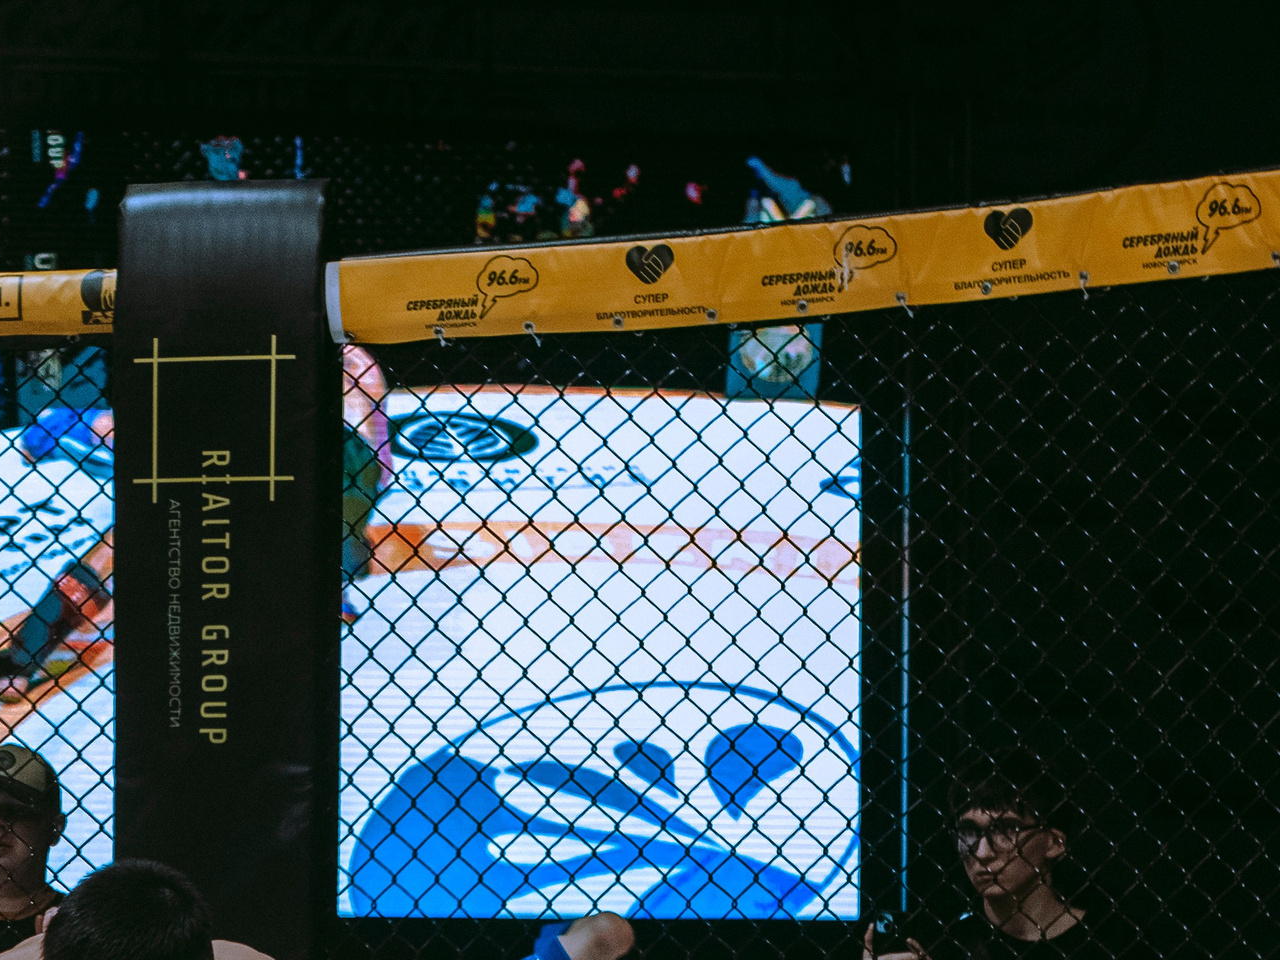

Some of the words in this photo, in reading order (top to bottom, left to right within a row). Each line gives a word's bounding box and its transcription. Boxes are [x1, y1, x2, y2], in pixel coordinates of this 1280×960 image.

[1122, 226, 1199, 248] СЕРЕБРЯНЫЙ
[1154, 244, 1198, 259] ДОЖДЬ
[991, 258, 1027, 272] СУПЕР
[761, 266, 836, 286] СЕРЕБРЯНЫЙ
[793, 283, 835, 296] ДОЖДЬ
[406, 294, 479, 311] СЕРЕБРЯНЫЙ
[634, 293, 669, 304] СУПЕР
[437, 309, 477, 322] ДОЖДЬ
[167, 498, 182, 590] АГЕНТСТВО
[166, 593, 182, 729] НЕДВИЖИМОСТИ
[198, 624, 231, 745] GROUP
